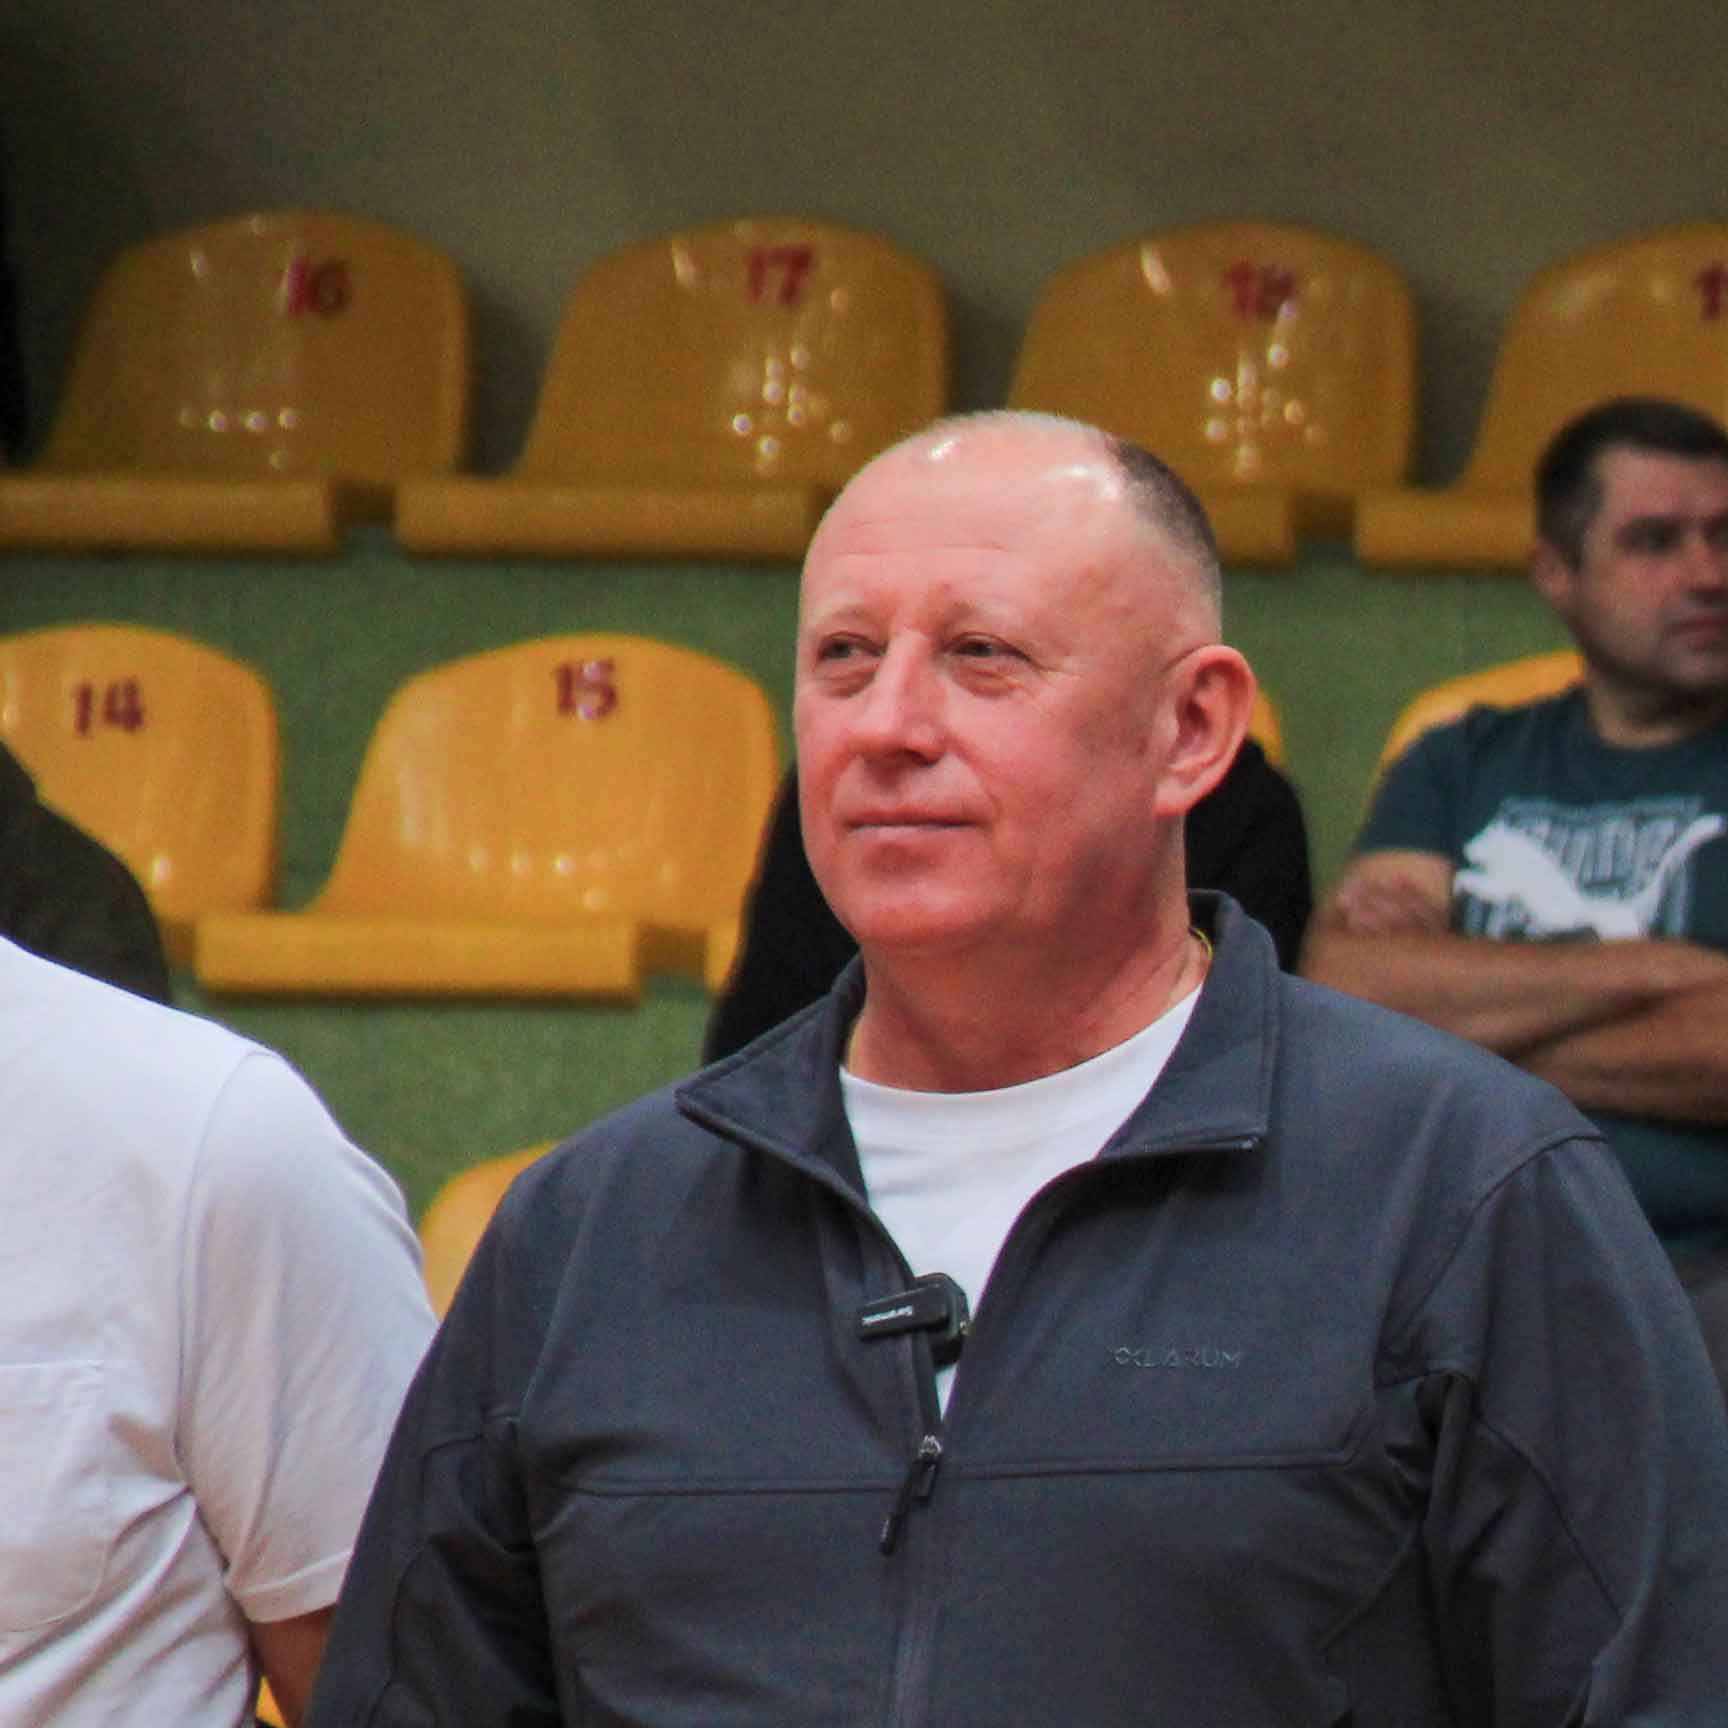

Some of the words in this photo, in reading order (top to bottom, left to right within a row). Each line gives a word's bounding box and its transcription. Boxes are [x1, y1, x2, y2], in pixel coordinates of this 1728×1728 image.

[748, 245, 814, 307] 17
[74, 679, 145, 737] 14
[555, 659, 620, 719] 15
